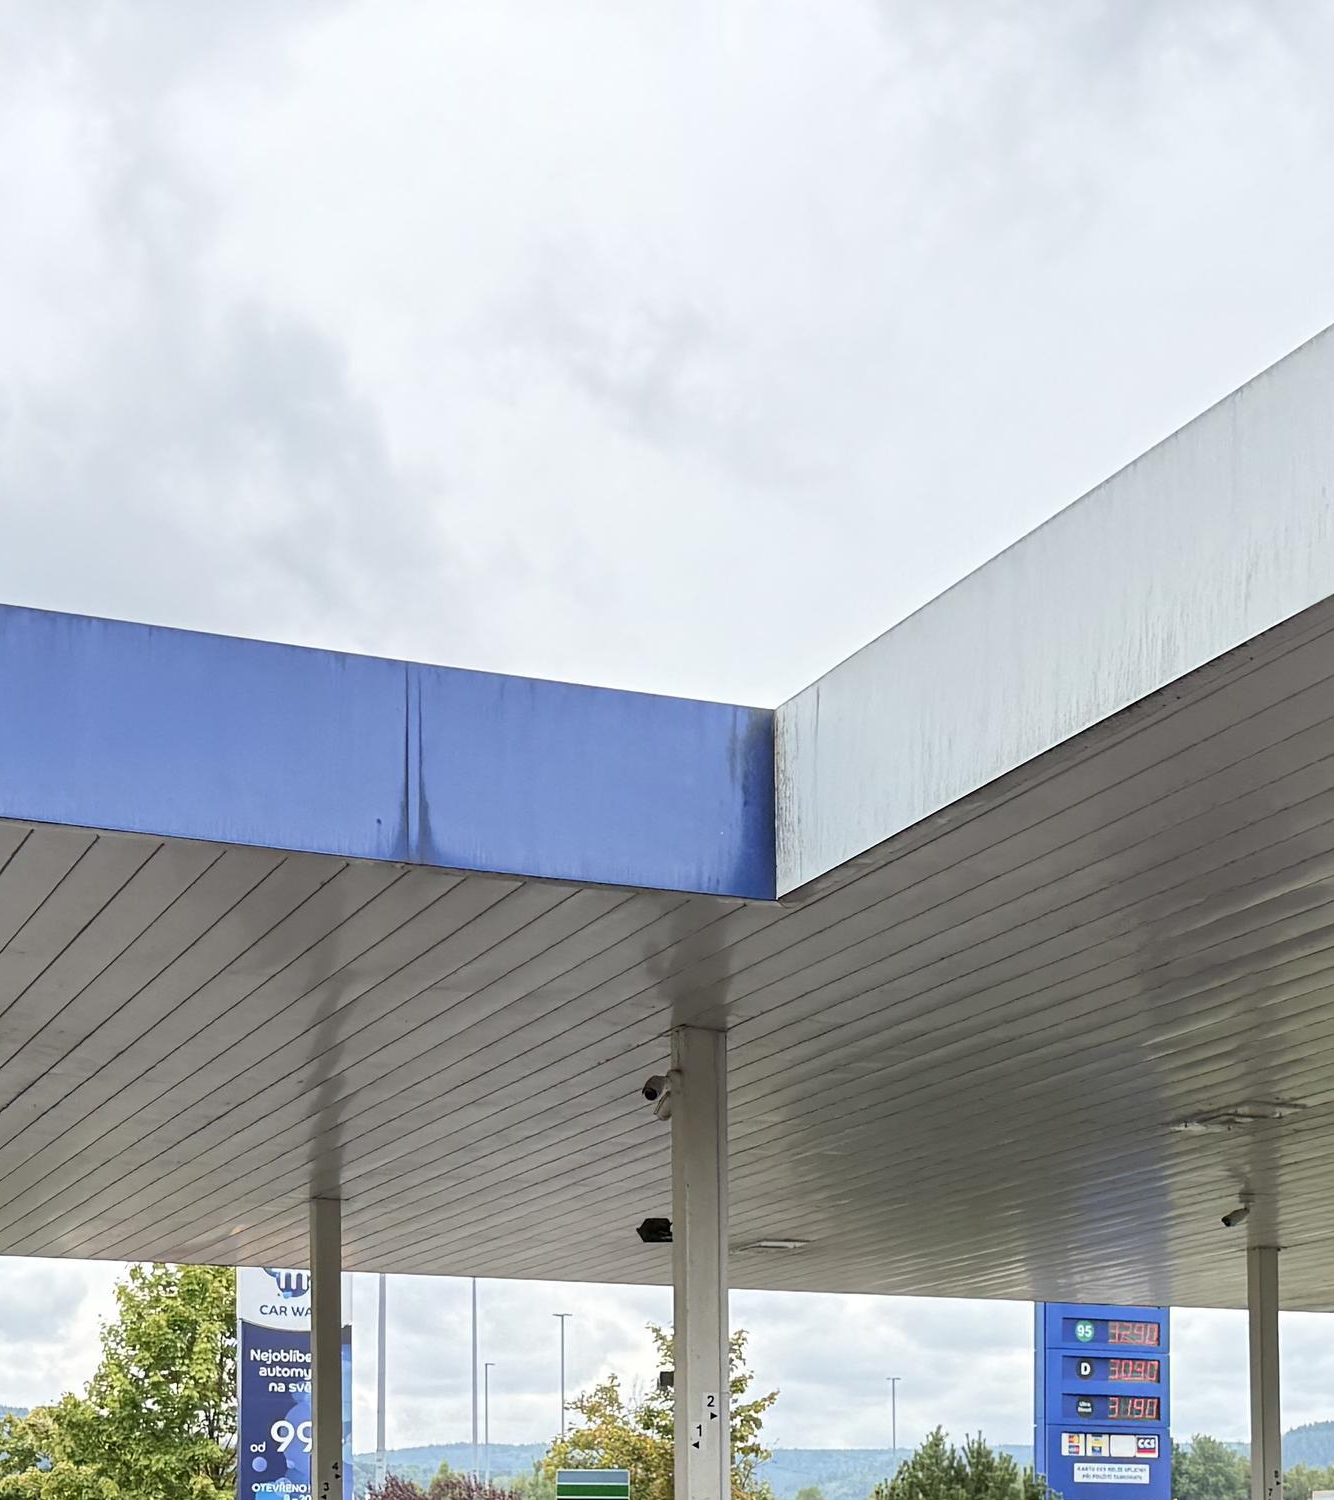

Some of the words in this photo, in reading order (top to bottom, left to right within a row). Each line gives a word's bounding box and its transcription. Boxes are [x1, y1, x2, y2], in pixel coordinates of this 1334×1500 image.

[259, 1304, 287, 1316] CAR
[1077, 1324, 1092, 1337] 95
[1080, 1362, 1091, 1375] D
[269, 1382, 286, 1392] na
[706, 1395, 715, 1408] 2
[696, 1424, 703, 1437] 1
[250, 1441, 266, 1452] od
[1137, 1438, 1156, 1449] CCS
[251, 1482, 307, 1493] OTEVŘENO
